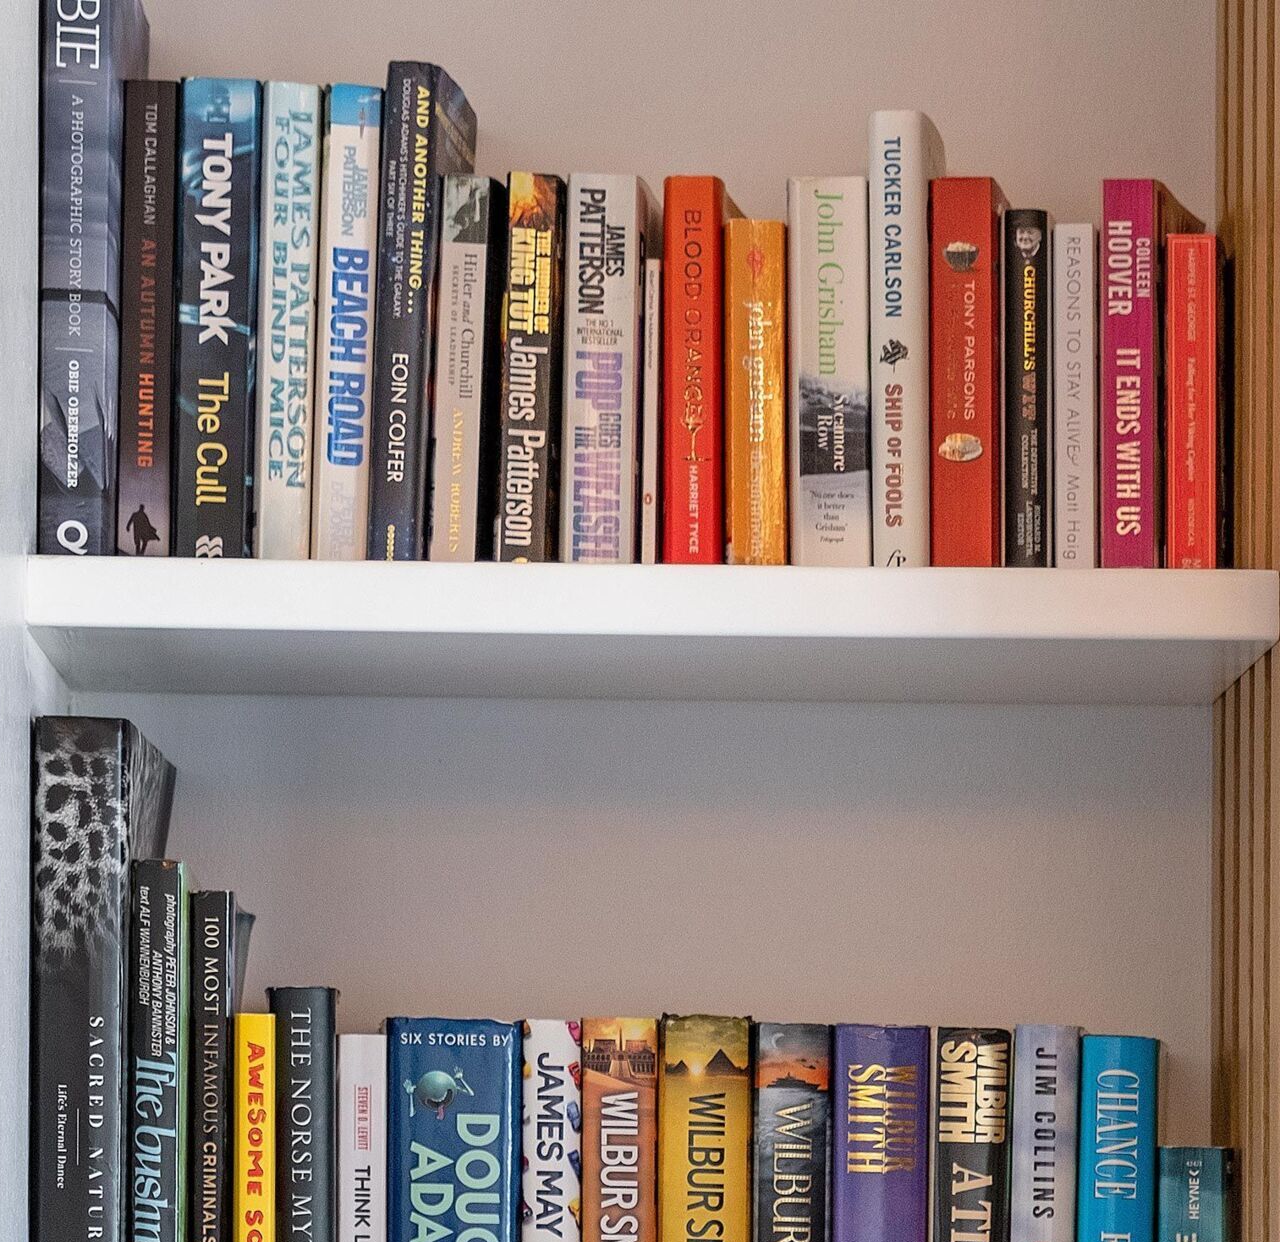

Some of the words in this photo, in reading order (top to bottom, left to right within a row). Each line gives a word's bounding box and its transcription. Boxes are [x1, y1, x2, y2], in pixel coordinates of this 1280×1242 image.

[71, 94, 84, 106] A
[144, 103, 158, 134] TOM
[70, 110, 84, 235] PHOTOGRAPHIC
[143, 137, 157, 226] CALLAGHAN
[194, 132, 233, 237] TONY
[273, 115, 290, 228] FOUR
[288, 109, 314, 250] JAMES
[341, 144, 357, 237] PATTERSON
[353, 166, 368, 219] JAMES
[884, 136, 902, 217] TUCKER
[140, 240, 157, 268] AN
[578, 187, 607, 315] PATTERSON
[605, 224, 626, 277] JAMES
[814, 189, 844, 255] John
[69, 239, 82, 290] STORY
[464, 253, 478, 298] Hitler
[510, 227, 536, 285] KING
[884, 224, 903, 318] CARLSON
[1107, 220, 1133, 316] HOOVER
[1135, 237, 1151, 298] COLLEEN
[68, 293, 82, 337] BOOK
[139, 273, 156, 365] AUTUMN
[198, 242, 236, 346] PARK
[270, 240, 288, 364] BLIND
[328, 246, 370, 364] BEACH
[462, 301, 474, 325] and
[509, 288, 534, 336] TUT
[817, 262, 845, 376] Grisham
[963, 280, 976, 329] TONY
[1023, 265, 1036, 371] CHURCHILL'S
[68, 359, 80, 394] OBIE
[285, 262, 311, 489] PATTERSON
[391, 353, 409, 404] EOIN
[459, 328, 475, 399] Churchill
[508, 337, 548, 422] James
[576, 351, 623, 411] POP
[963, 335, 976, 421] PARSONS
[1116, 348, 1141, 370] IT
[137, 373, 154, 468] HUNTING
[197, 372, 230, 434] The
[326, 371, 366, 467] ROAD
[884, 383, 903, 432] SHIP
[1022, 372, 1037, 421] WIT
[1116, 375, 1141, 436] ENDS
[67, 397, 79, 488] OBERHOLZER
[268, 378, 285, 481] MICE
[386, 409, 407, 483] COLFER
[574, 426, 598, 449] THE
[598, 412, 622, 448] GOES
[817, 413, 834, 451] Row
[832, 394, 850, 473] Sycamore
[886, 436, 902, 458] OF
[195, 441, 228, 506] Cull
[504, 428, 546, 546] Patterson
[688, 465, 699, 519] HARRIET
[885, 462, 904, 528] FOOLS
[1116, 440, 1141, 499] WITH
[572, 450, 621, 562] WEASEL
[1116, 505, 1141, 536] US
[688, 522, 699, 555] TYCE
[139, 905, 150, 926] ALF
[140, 886, 150, 904] text
[163, 893, 176, 955] photography
[204, 915, 220, 949] 100
[138, 927, 150, 1006] WANNENBURGH
[151, 950, 163, 999] ANTHONY
[165, 955, 176, 988] PETER
[203, 956, 220, 1016] MOST
[150, 999, 163, 1057] BANNISTER
[164, 988, 176, 1036] JOHNSON
[165, 1036, 176, 1045] &
[290, 1007, 312, 1068] THE
[400, 1032, 422, 1046] SIX
[428, 1033, 487, 1047] STORIES
[492, 1034, 510, 1047] BY
[57, 1083, 68, 1111] Life's
[87, 1016, 105, 1129] SACRED
[134, 1051, 177, 1120] The
[203, 1023, 220, 1134] INFAMOUS
[938, 1040, 979, 1144] SMITH
[975, 1041, 1008, 1144] WILBUR
[1034, 1047, 1058, 1096] JIM
[56, 1113, 68, 1152] Eternal
[246, 1041, 267, 1197] AWESOME
[291, 1078, 313, 1183] NORSE
[535, 1052, 565, 1162] JAMES
[847, 1063, 888, 1174] SMITH
[883, 1063, 918, 1174] WILBUR
[1094, 1068, 1141, 1200] CHANCE
[56, 1155, 68, 1189] Dance
[600, 1091, 639, 1210] WILBUR
[686, 1092, 726, 1212] WILBUR
[951, 1162, 993, 1196] A
[1032, 1110, 1057, 1220] COLLINS
[354, 1165, 371, 1229] THINK
[535, 1170, 564, 1239] MAY
